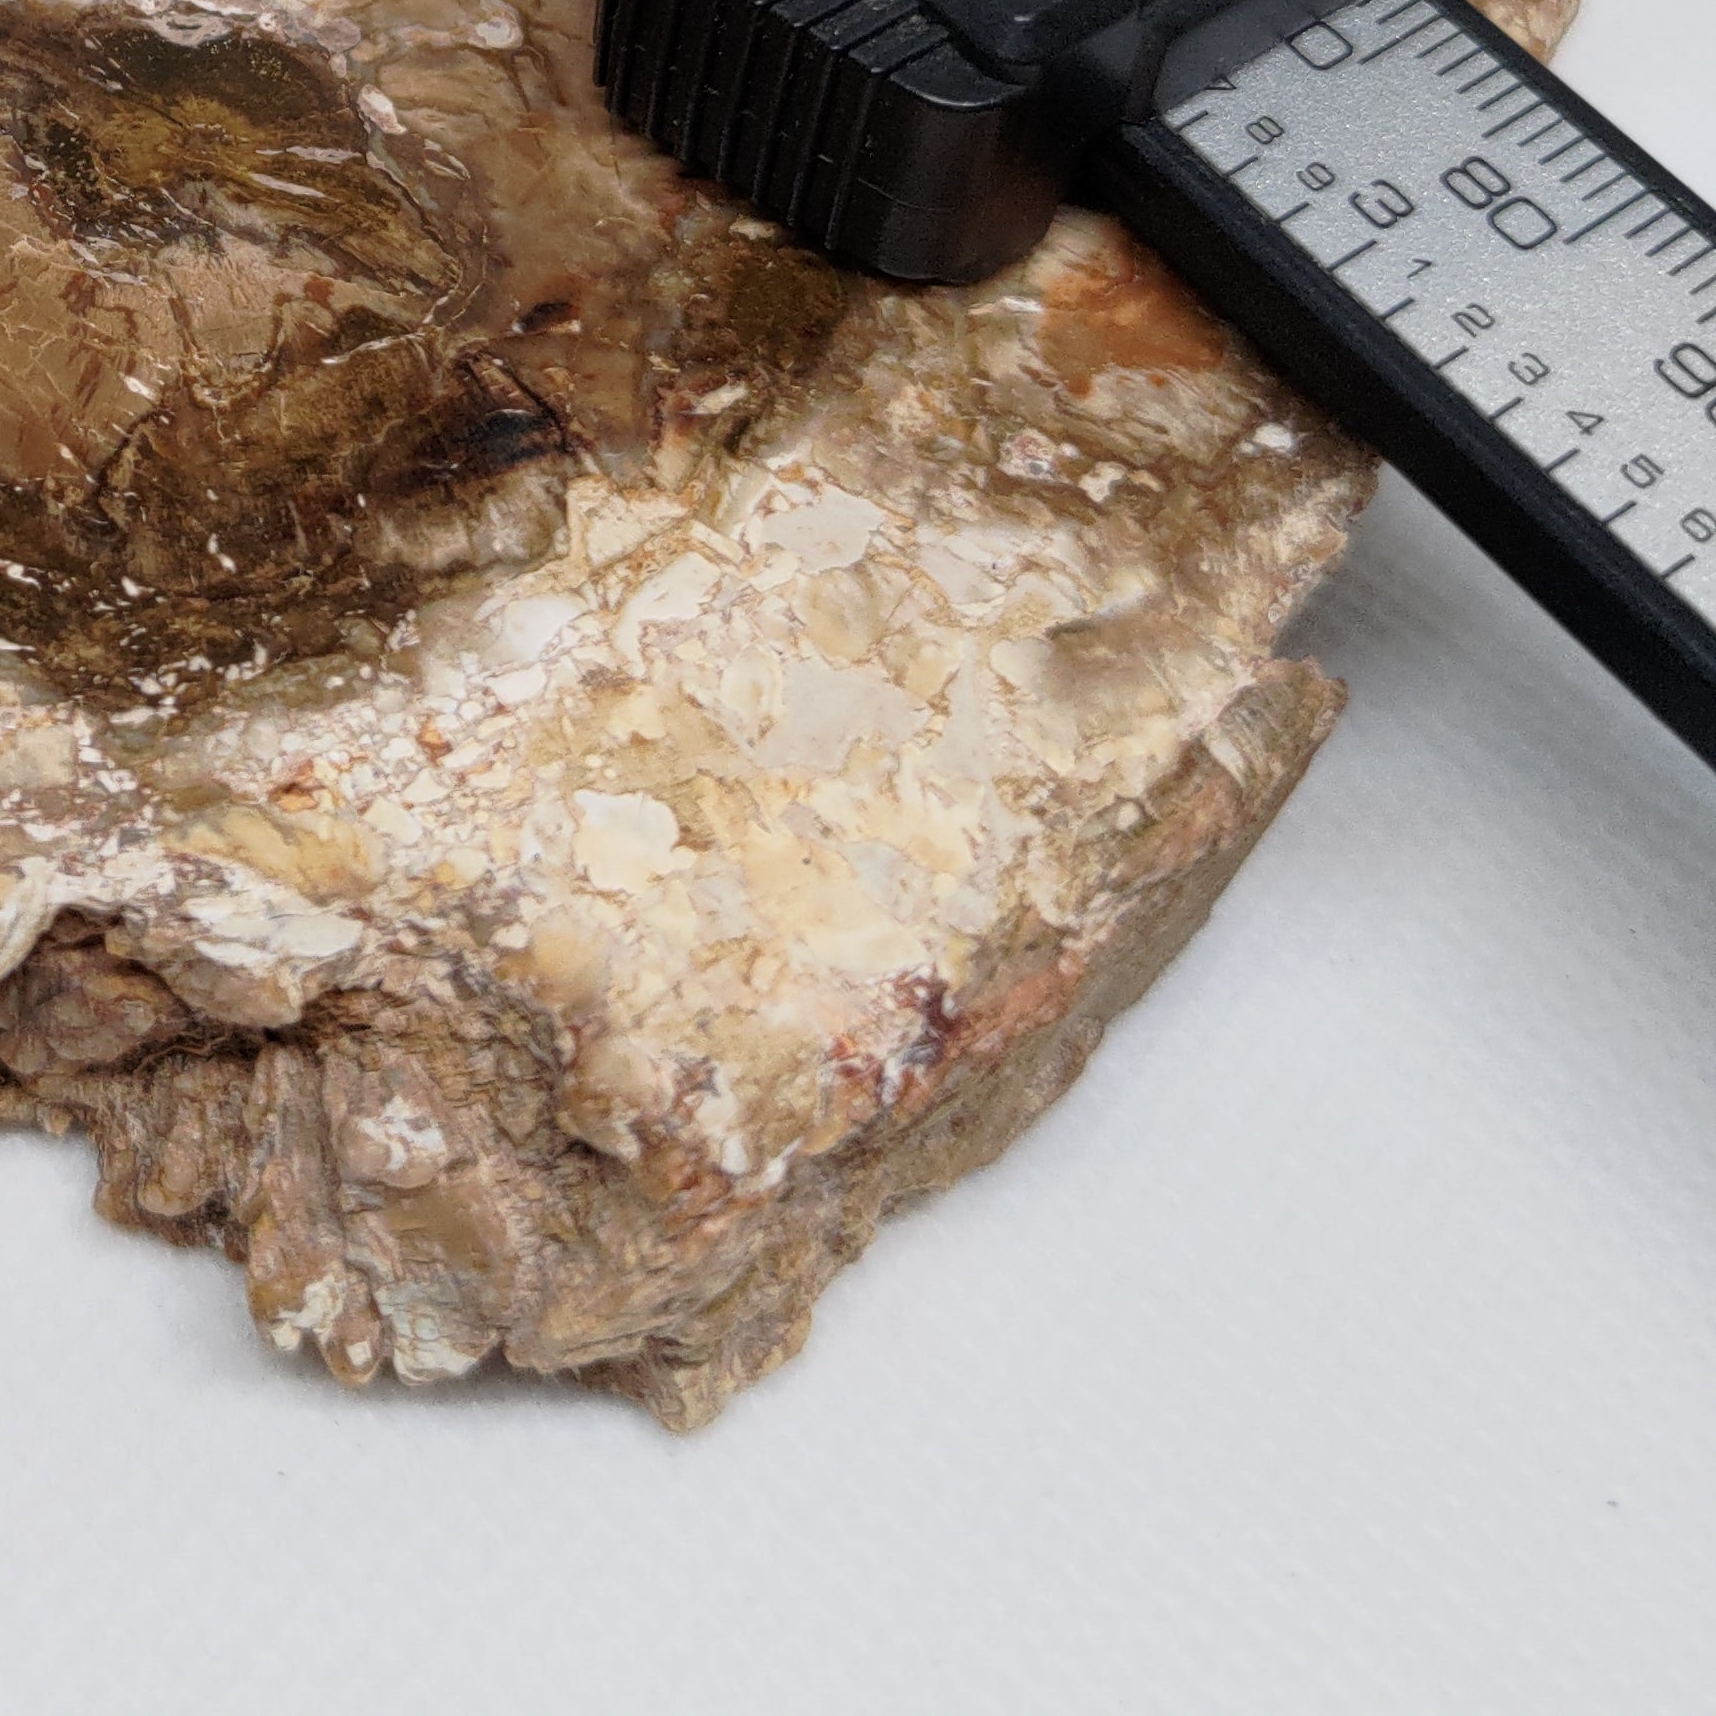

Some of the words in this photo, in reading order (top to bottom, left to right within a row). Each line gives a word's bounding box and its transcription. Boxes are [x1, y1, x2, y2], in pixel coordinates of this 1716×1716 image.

[1245, 115, 1284, 145] 8
[1348, 179, 1415, 229] 3
[1450, 302, 1497, 337] 2
[1508, 351, 1551, 385] 3
[1565, 407, 1605, 436] 4
[1619, 453, 1666, 490] 5
[1439, 156, 1558, 251] 80
